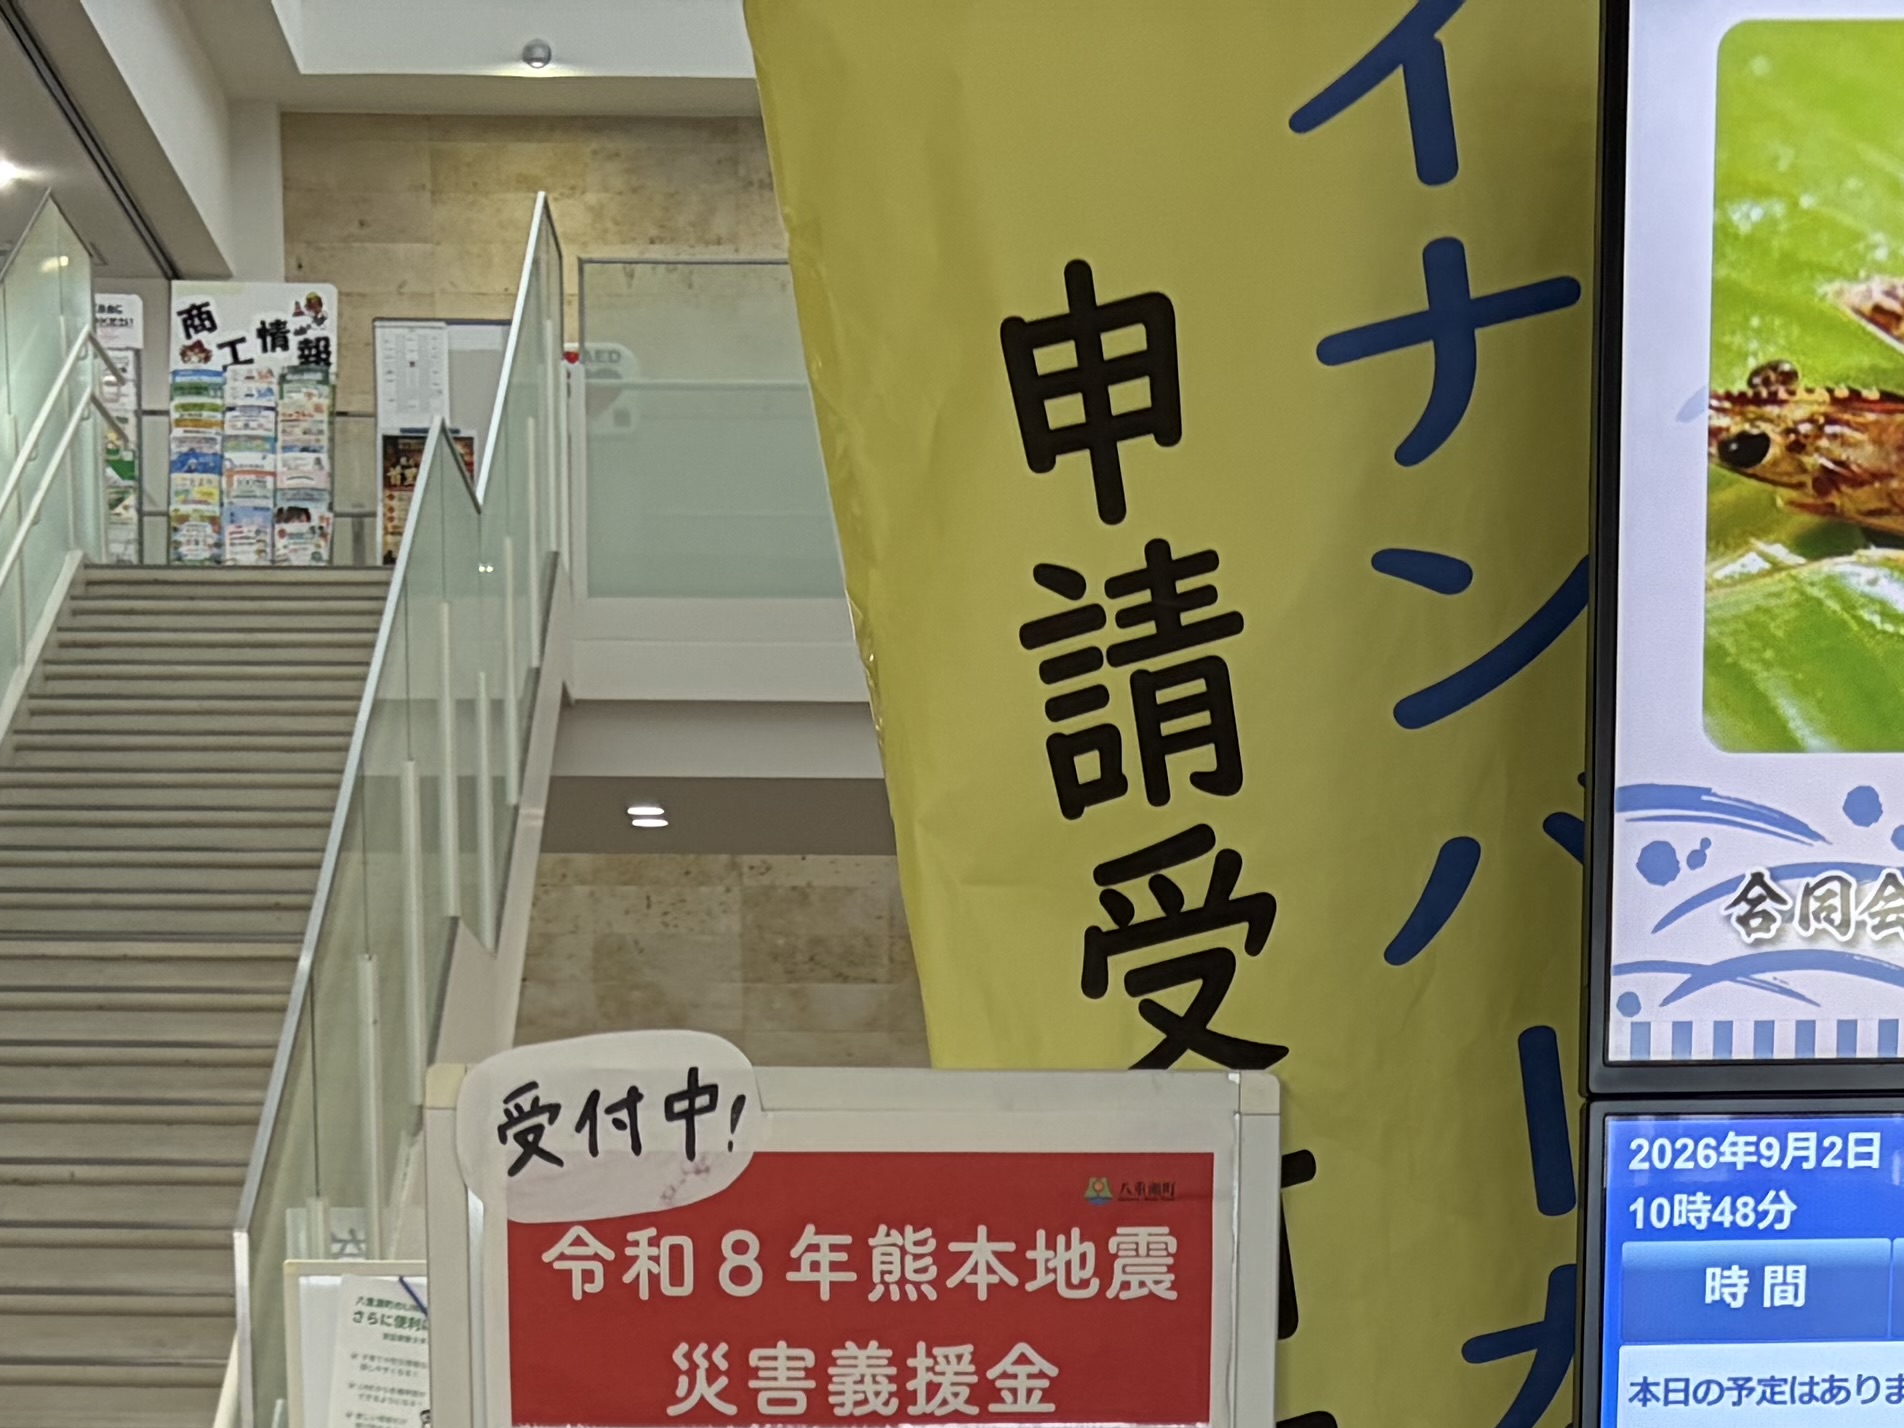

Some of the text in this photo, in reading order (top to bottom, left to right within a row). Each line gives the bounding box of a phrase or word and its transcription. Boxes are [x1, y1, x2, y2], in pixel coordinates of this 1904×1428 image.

[176, 299, 333, 368] 商工情報
[1629, 1130, 1884, 1174] 2026年9月2日
[1629, 1188, 1798, 1233] 10時48分
[541, 1224, 1179, 1303] 令和8年熊本地震
[666, 1340, 1061, 1417] 災害義援金
